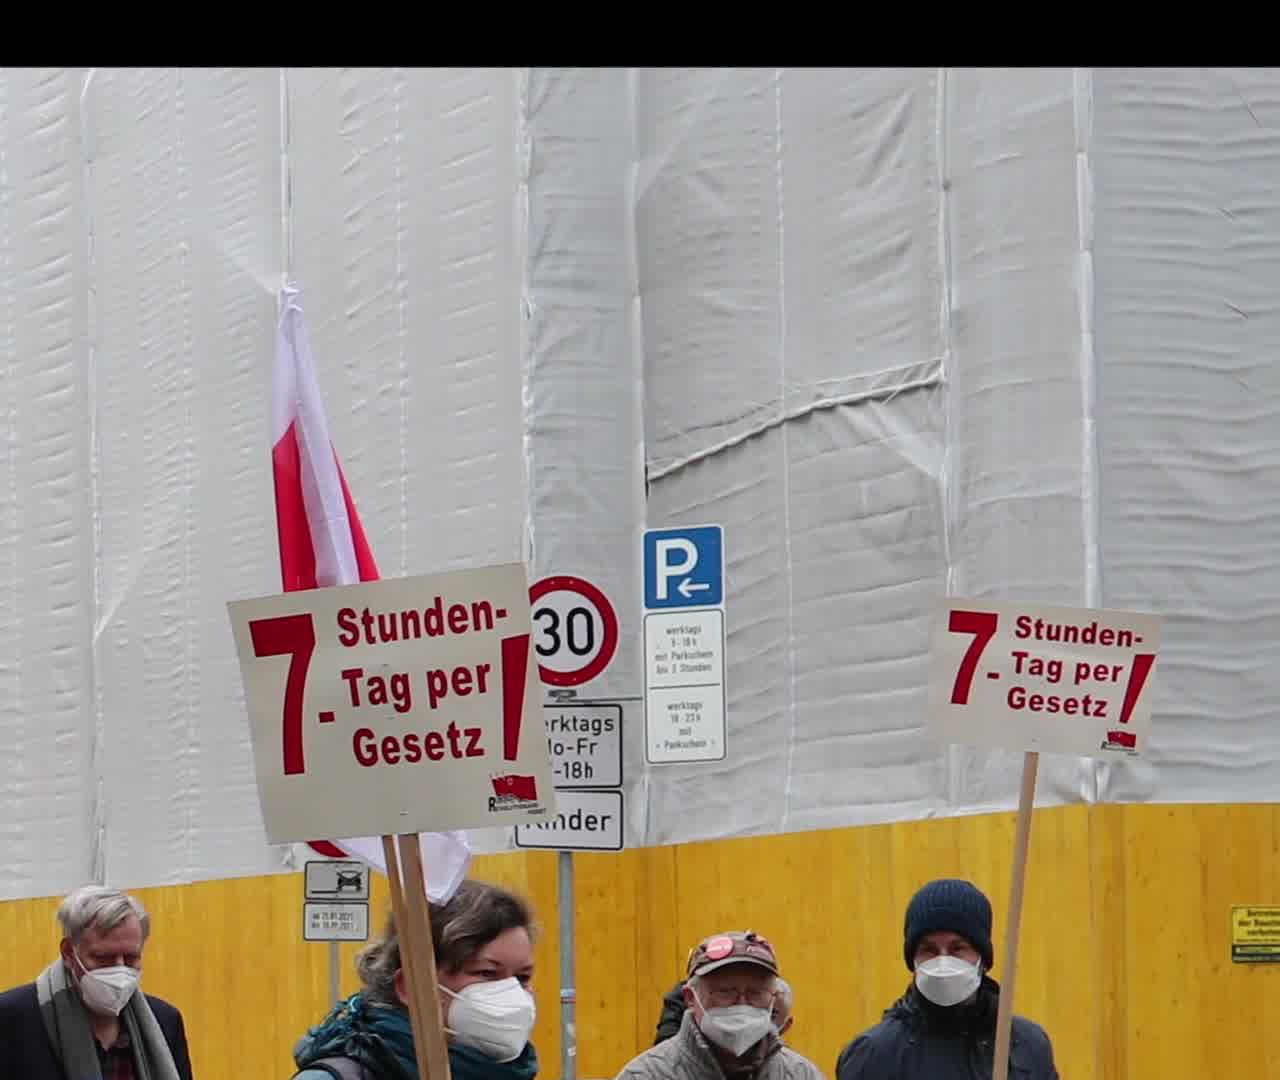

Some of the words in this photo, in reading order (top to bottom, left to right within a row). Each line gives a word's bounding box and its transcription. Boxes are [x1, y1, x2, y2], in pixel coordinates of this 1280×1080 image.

[655, 538, 699, 600] P
[337, 596, 508, 647] Stunden-
[532, 607, 594, 656] 30
[1015, 615, 1143, 648] Stunden-
[341, 667, 411, 713] Tag
[426, 663, 491, 709] per
[1011, 651, 1063, 684] Tag
[1074, 661, 1123, 686] per
[1007, 686, 1108, 718] Gesetz
[352, 721, 486, 767] Gesetz
